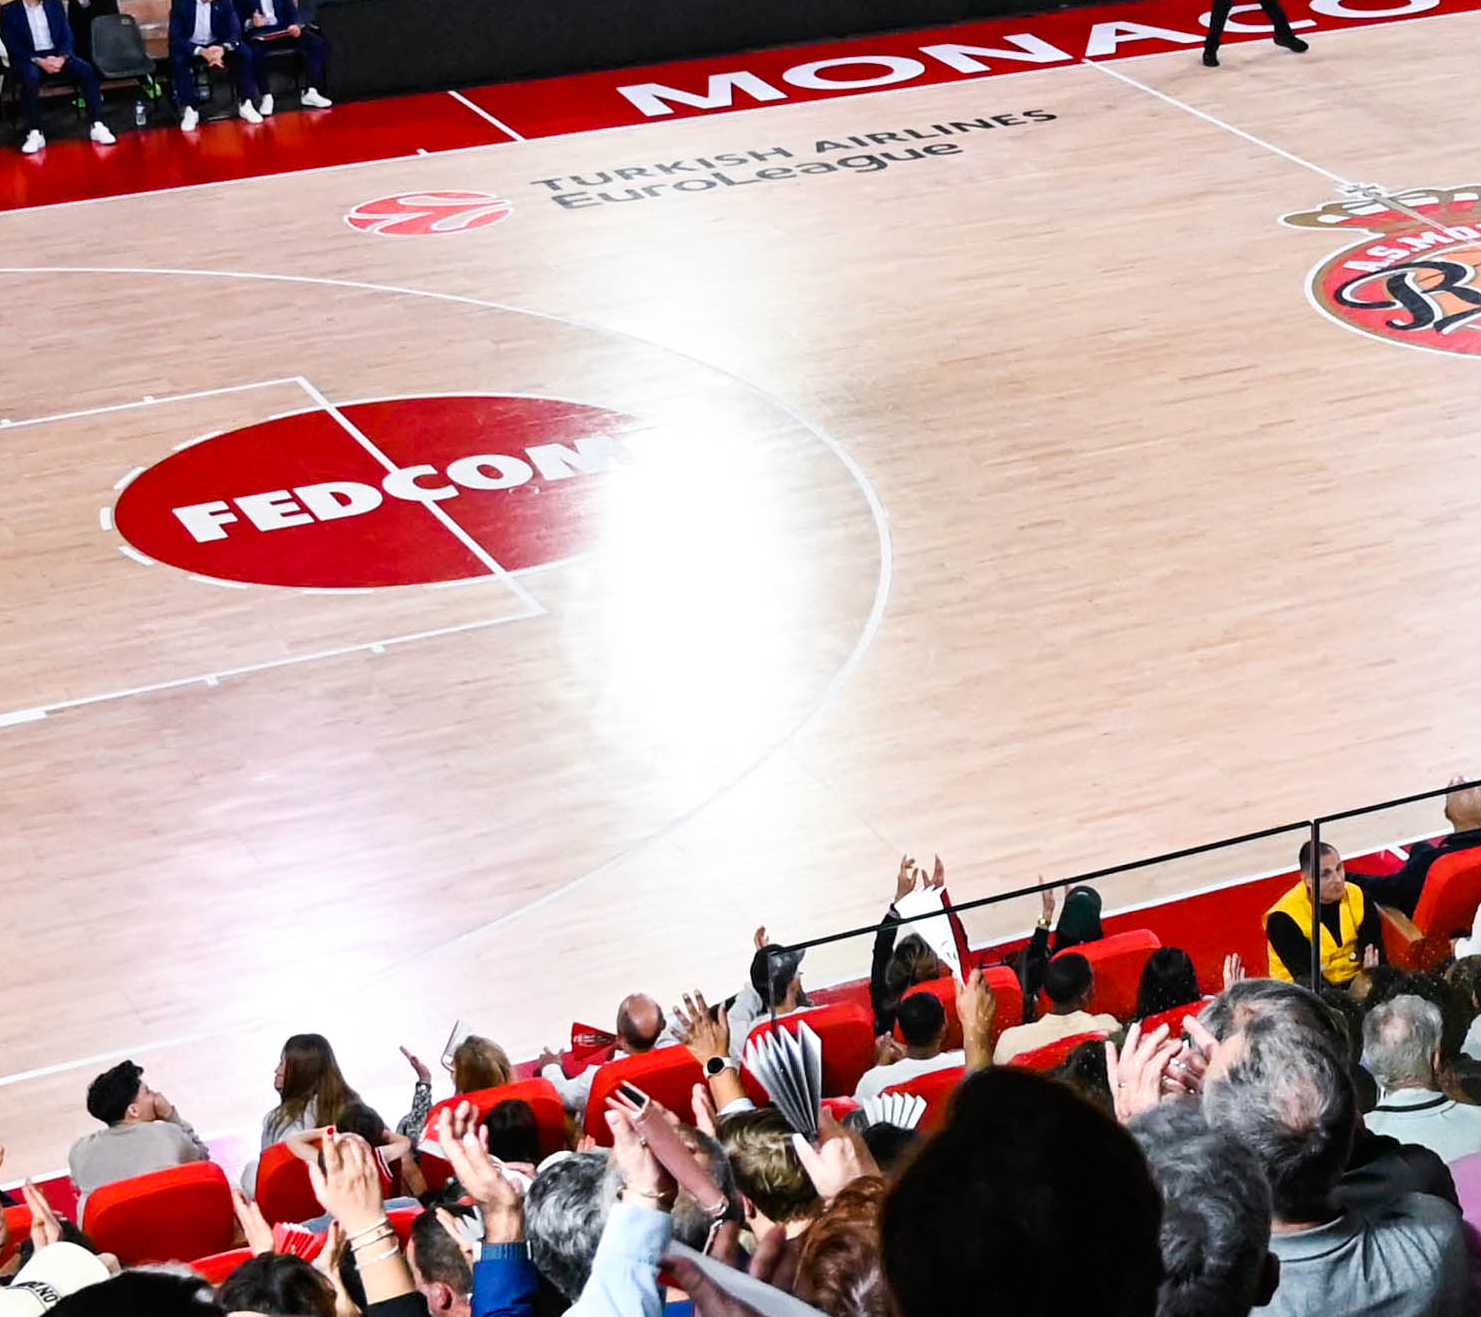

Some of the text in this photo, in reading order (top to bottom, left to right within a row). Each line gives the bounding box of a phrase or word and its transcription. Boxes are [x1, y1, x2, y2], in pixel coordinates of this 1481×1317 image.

[531, 109, 1059, 192] TURKISH AIRLINES
[551, 141, 964, 210] EuroLeague
[172, 435, 633, 543] FEDCOM
